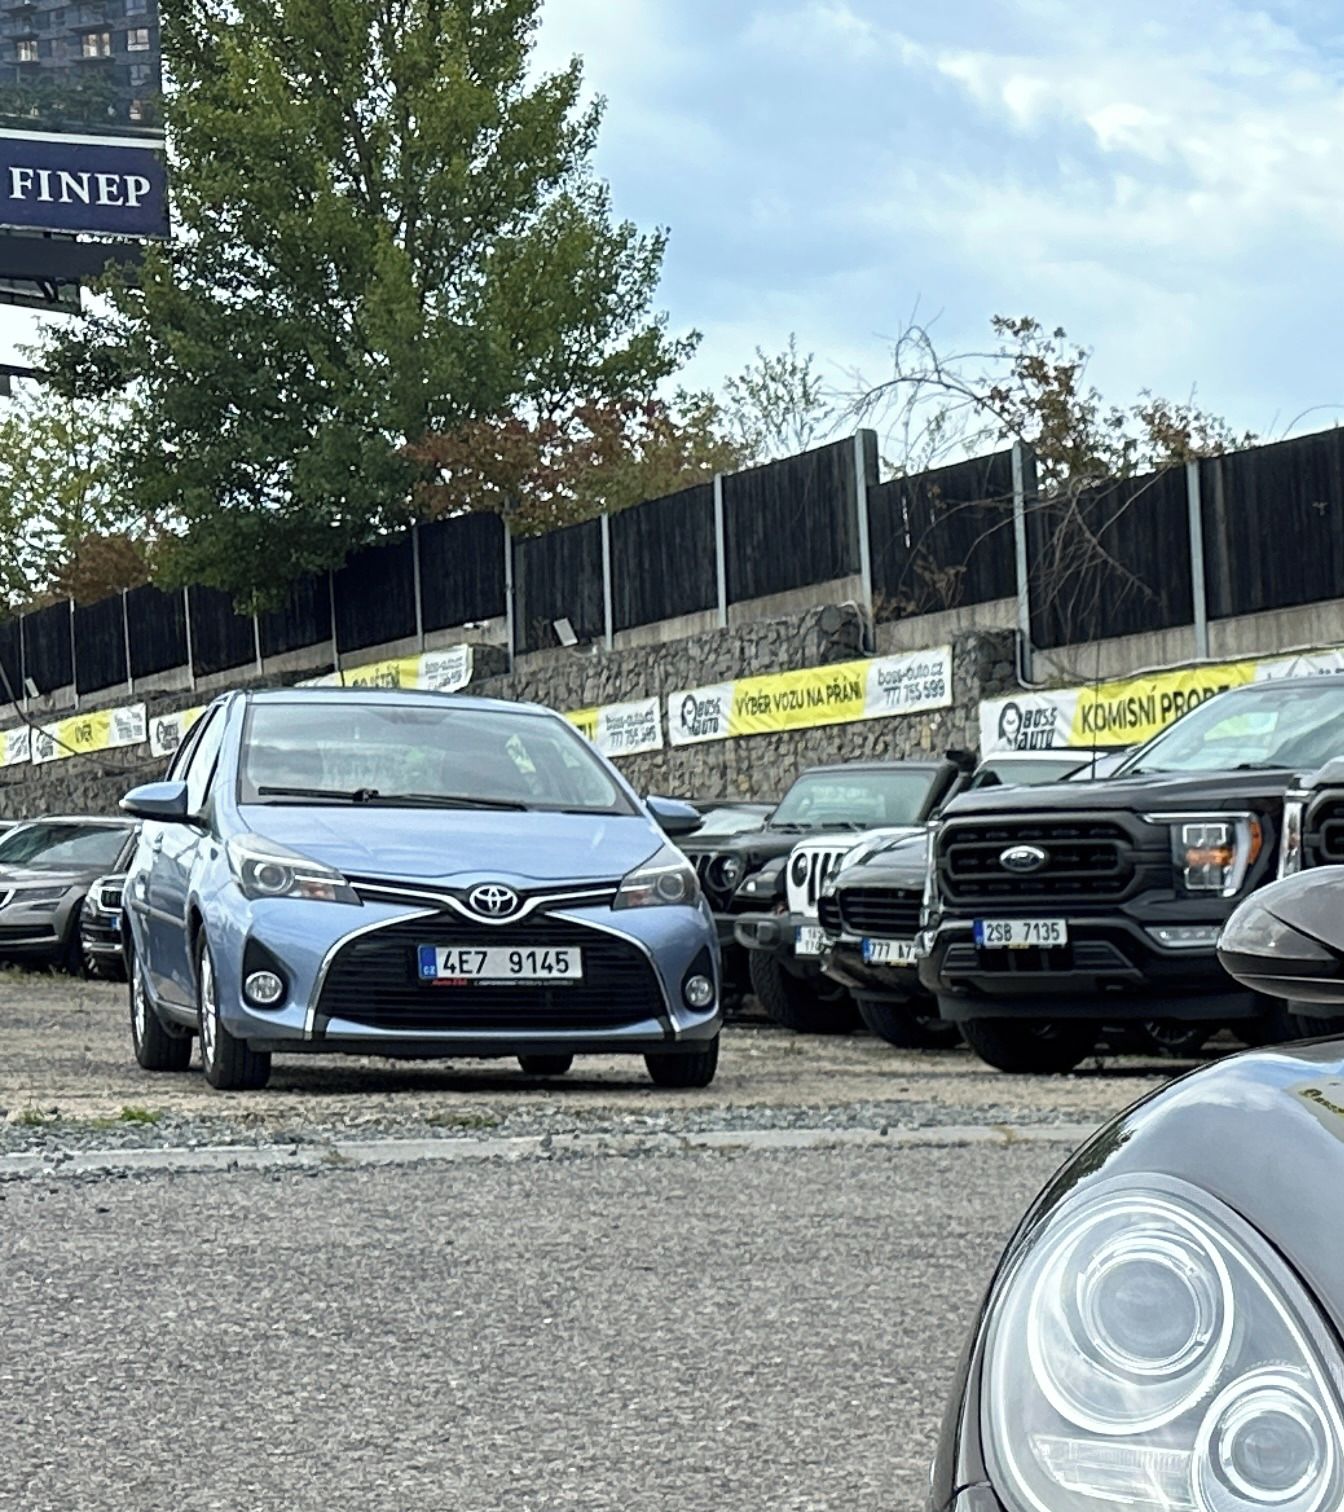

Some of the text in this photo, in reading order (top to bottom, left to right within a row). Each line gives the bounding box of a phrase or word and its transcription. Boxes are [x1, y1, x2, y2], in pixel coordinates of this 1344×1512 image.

[8, 166, 151, 207] FINEP
[736, 673, 864, 718] VÝBĚR VOZU NA PŘÁNÍ
[1082, 685, 1157, 734] KOMISNÍ
[1022, 707, 1059, 729] BOSS
[986, 921, 1061, 943] 2SB 7135
[442, 950, 570, 975] 4E7 9145
